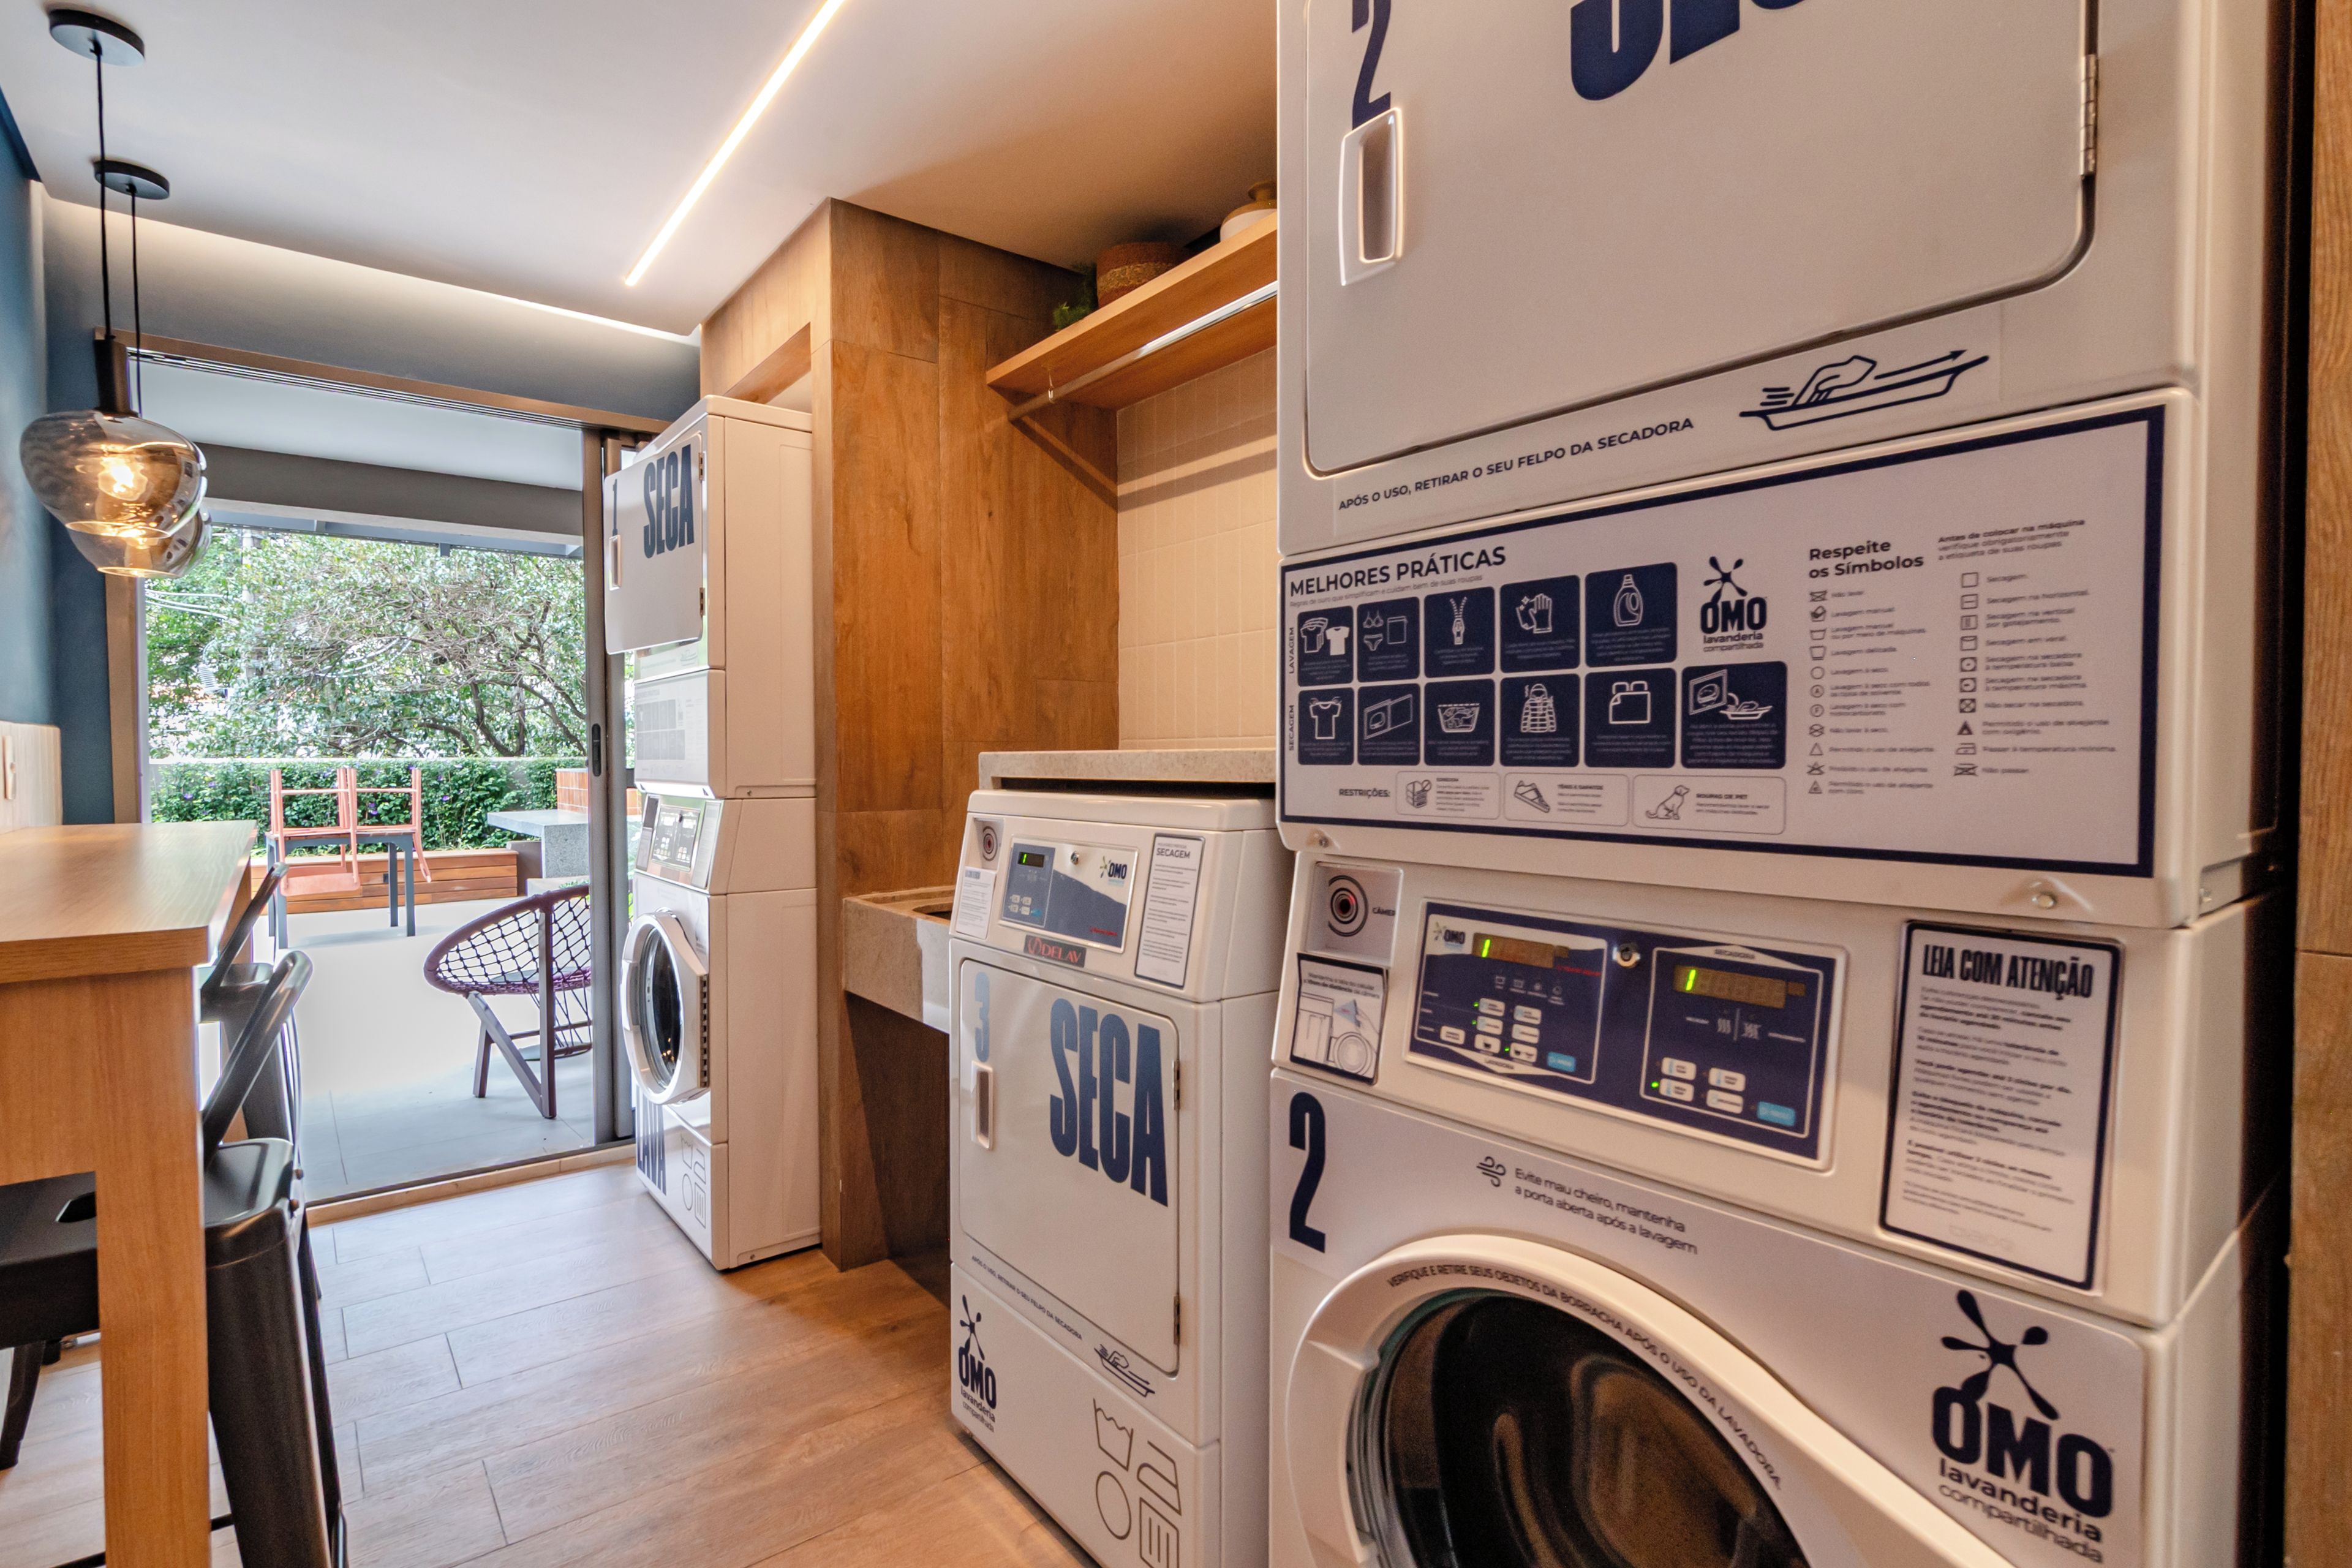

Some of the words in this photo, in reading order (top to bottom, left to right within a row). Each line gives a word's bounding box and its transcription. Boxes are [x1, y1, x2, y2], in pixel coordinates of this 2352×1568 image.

[1338, 493, 1369, 511] APÓS
[1372, 492, 1381, 502] O
[1384, 485, 1411, 500] USO,
[1414, 470, 1469, 492] RETIRAR
[1472, 467, 1482, 478] O
[1486, 459, 1514, 475] SEU
[1518, 447, 1566, 469] FELPO
[1570, 442, 1593, 456] DA
[1597, 417, 1694, 450] SECADORA
[643, 443, 695, 559] SECA
[1291, 565, 1390, 597] MELHORES
[1397, 546, 1506, 581] PRÁTICAS
[1809, 540, 1891, 560] Respeite
[1809, 567, 1829, 579] os
[1834, 556, 1924, 576] Símbolos
[1700, 597, 1767, 635] OMO
[1703, 630, 1763, 644] lavanderia
[1339, 788, 1391, 799] RESTRIÇÕES:
[1107, 862, 1128, 880] OMO
[1156, 847, 1191, 858] SECAGEM
[1922, 944, 1954, 979] LEIA
[1960, 949, 2003, 986] COM
[2006, 956, 2094, 1001] ATENÇÃO
[974, 971, 990, 1063] 3
[1049, 997, 1169, 1208] SECA
[1289, 1091, 1325, 1254] 2
[1515, 1167, 1542, 1186] Evite
[1544, 1178, 1572, 1196] mau
[1574, 1188, 1613, 1210] cheiro,
[1616, 1202, 1686, 1233] mantenha
[1515, 1185, 1522, 1195] a
[1523, 1188, 1554, 1206] porta
[1556, 1199, 1594, 1219] aberta
[1596, 1212, 1627, 1231] após
[1629, 1224, 1637, 1234] a
[1638, 1224, 1698, 1255] lavagem
[1387, 1265, 1429, 1287] VERIFIQUE
[1430, 1265, 1436, 1275] E
[1437, 1264, 1468, 1275] RETIRE
[1469, 1265, 1493, 1279] SEUS
[1494, 1270, 1540, 1292] OBJETOS
[1542, 1284, 1558, 1300] DA
[1559, 1292, 1624, 1332] BORRACHA
[1626, 1327, 1659, 1356] APÓS
[1660, 1352, 1670, 1365] O
[1671, 1361, 1699, 1388] USO
[1699, 1386, 1717, 1409] DA
[959, 1346, 997, 1409] OMO
[960, 1385, 995, 1423] lavanderia
[1932, 1386, 2113, 1518] OMO
[1939, 1458, 2102, 1544] lavanderia
[1939, 1484, 2103, 1564] compartilhada
